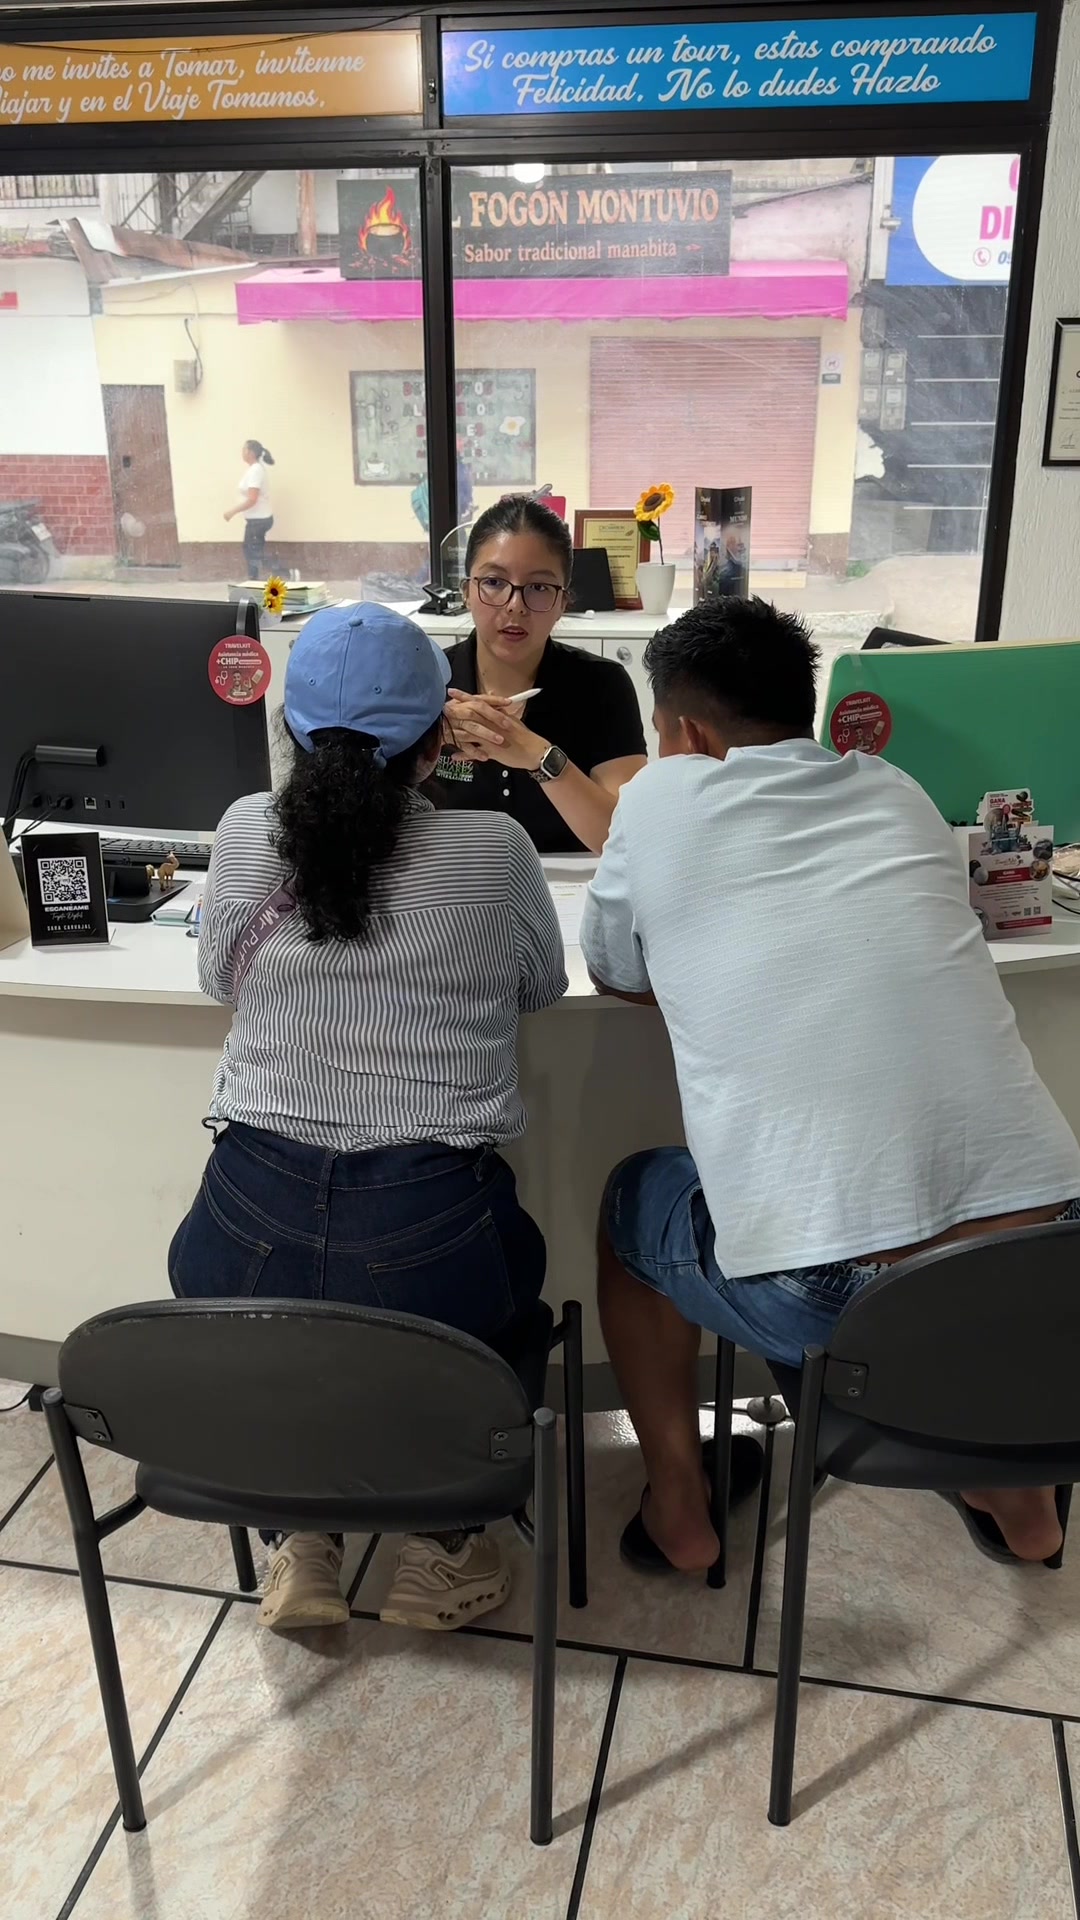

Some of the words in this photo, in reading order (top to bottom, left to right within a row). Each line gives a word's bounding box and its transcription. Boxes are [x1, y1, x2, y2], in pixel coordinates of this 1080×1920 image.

[22, 63, 56, 81] me
[62, 52, 131, 80] invites
[138, 61, 154, 78] a
[161, 47, 244, 79] Tomar,
[255, 46, 366, 74] invitenme
[464, 39, 495, 72] Si
[501, 47, 620, 77] compras
[626, 43, 665, 65] un
[671, 34, 741, 65] tour,
[754, 30, 823, 60] estas
[831, 24, 997, 67] comprando
[56, 97, 72, 123] y
[80, 96, 107, 112] en
[112, 84, 133, 112] el
[138, 79, 201, 120] Viaje
[658, 67, 716, 102] No
[722, 69, 751, 97] lo
[758, 67, 840, 97] dudes
[850, 63, 941, 95] Hazlo
[469, 181, 569, 227] FOGÓN
[577, 188, 719, 225] MONTUVIO
[464, 243, 511, 263] Sabor
[518, 240, 601, 262] tradicional
[608, 238, 677, 258] manabita
